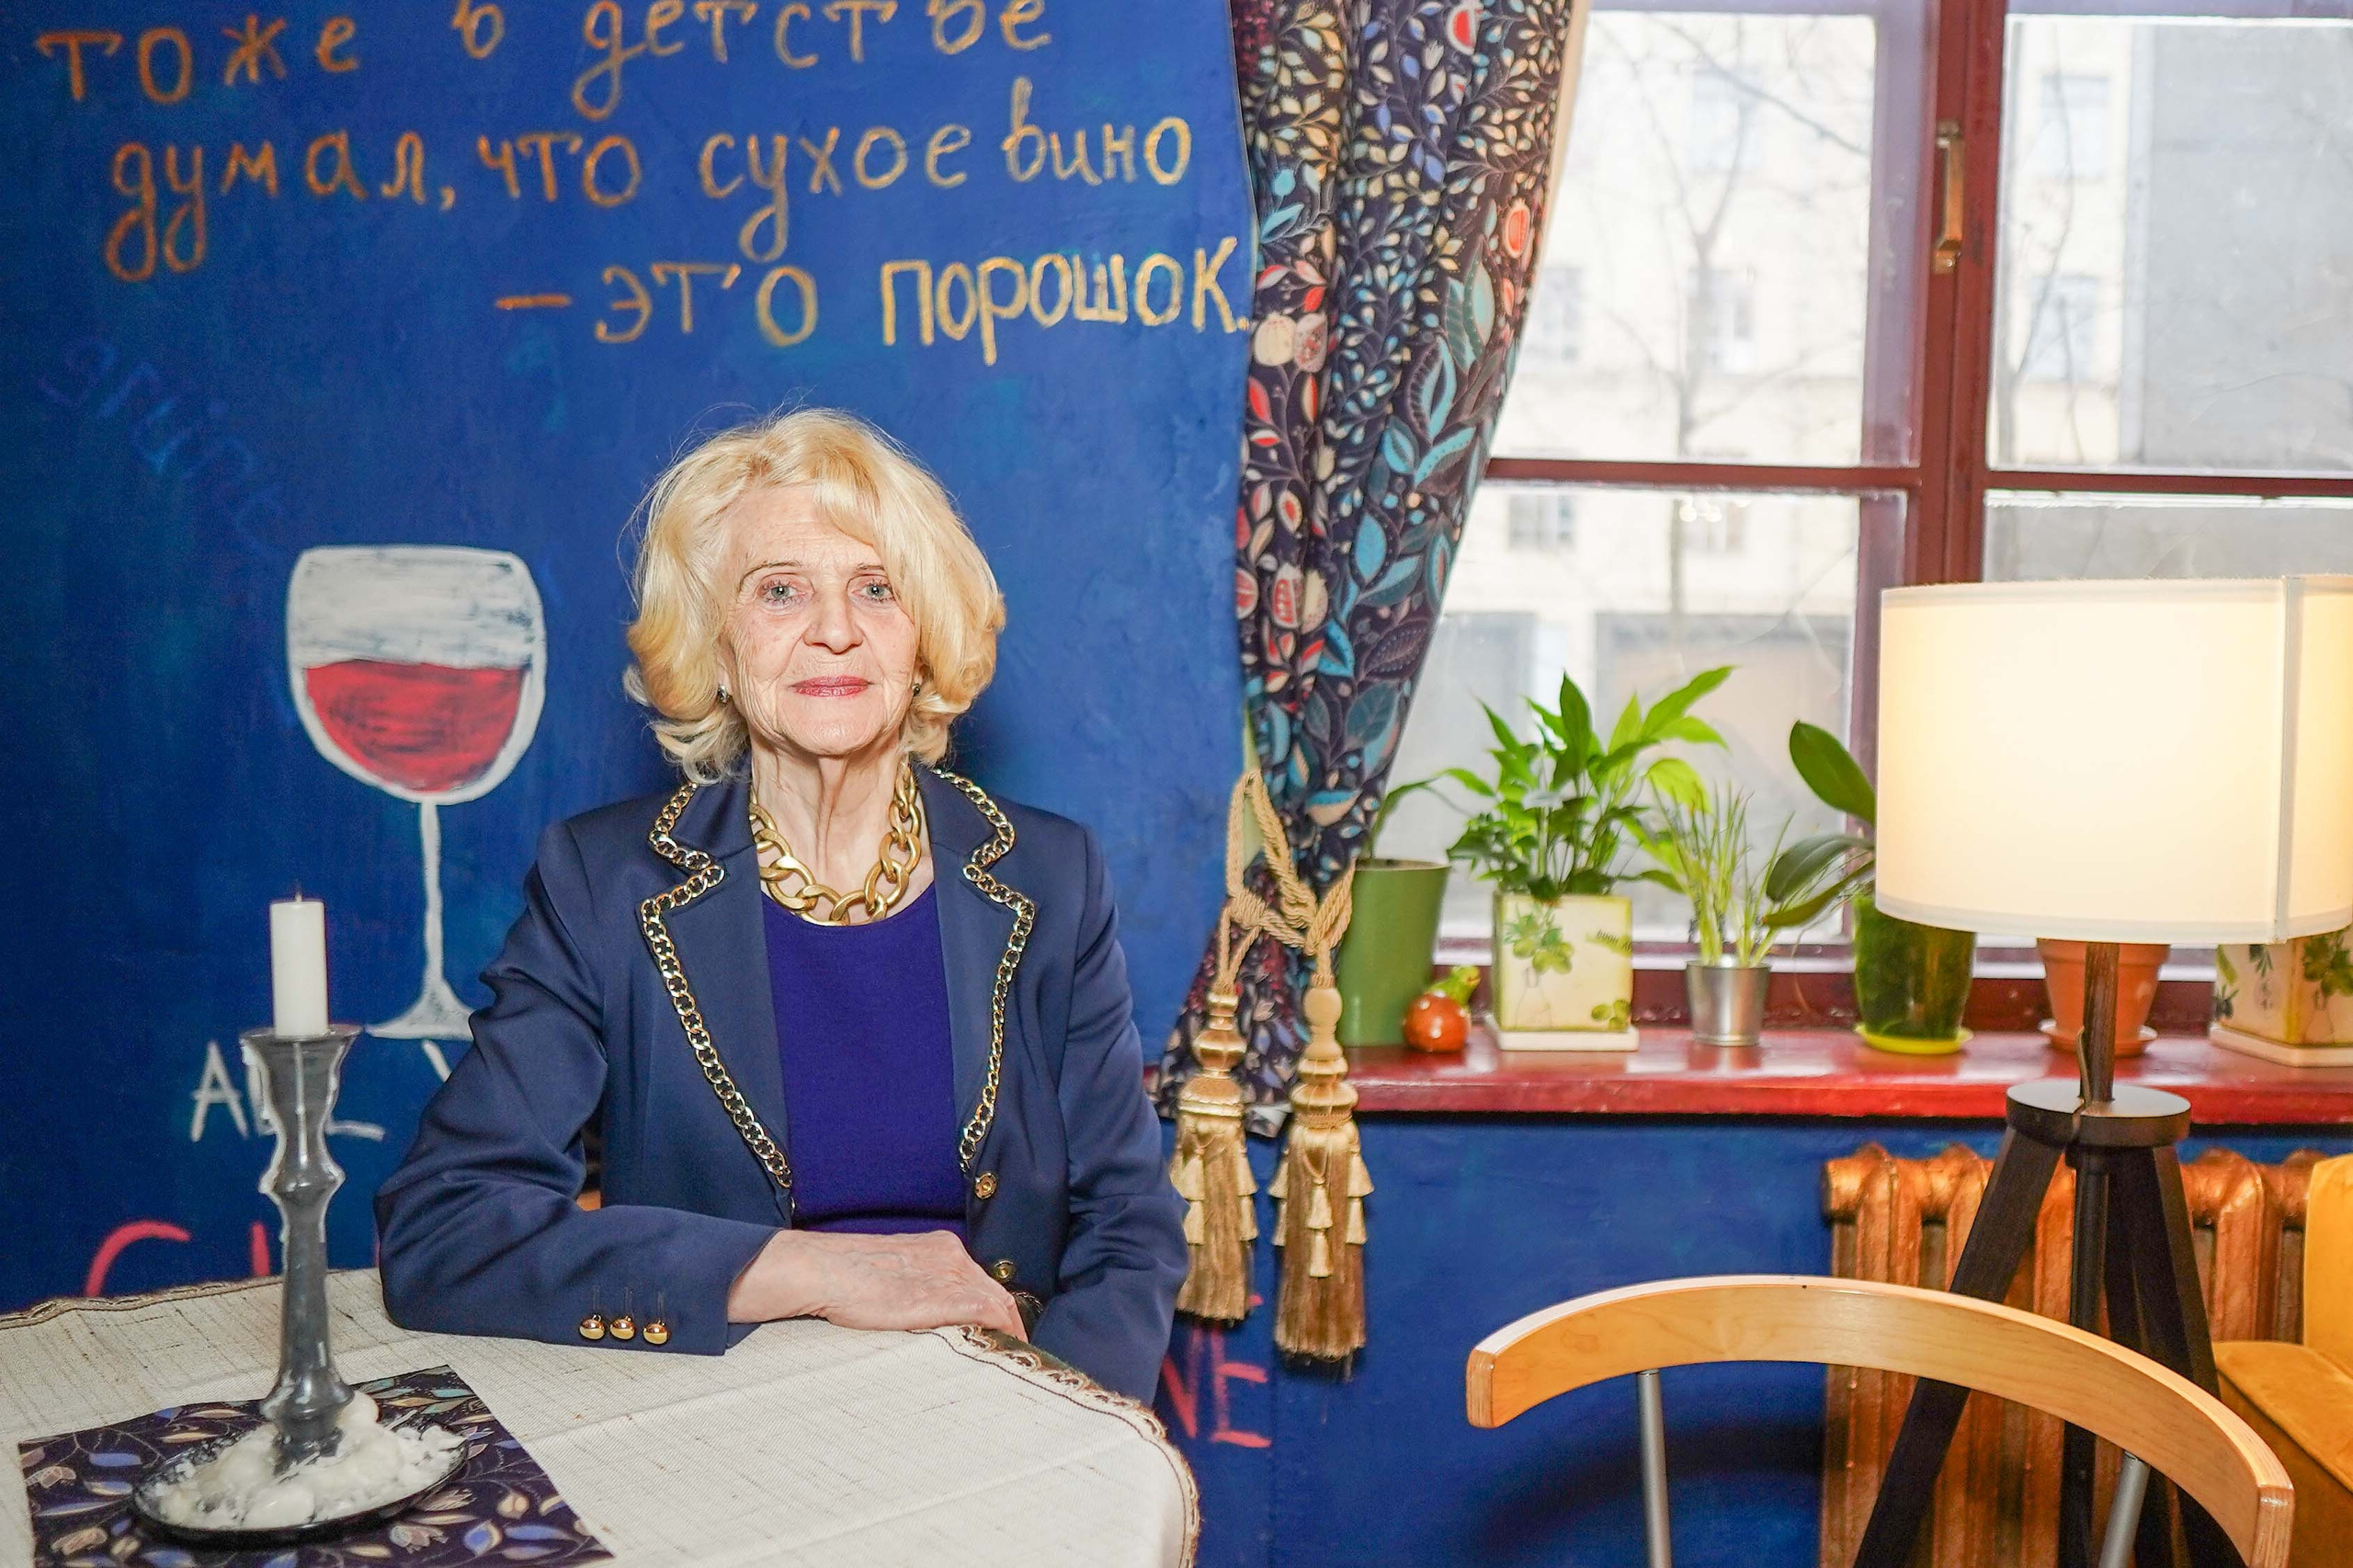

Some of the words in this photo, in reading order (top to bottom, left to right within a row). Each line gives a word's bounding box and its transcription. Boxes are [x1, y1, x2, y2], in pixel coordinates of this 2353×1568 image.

[35, 13, 360, 104] тоже
[571, 0, 1051, 121] детстве
[103, 131, 456, 283] думал,
[476, 134, 643, 208] что
[699, 124, 972, 263] сухое
[1001, 76, 1193, 187] вино
[593, 261, 820, 347] это
[880, 236, 1252, 367] порошок.
